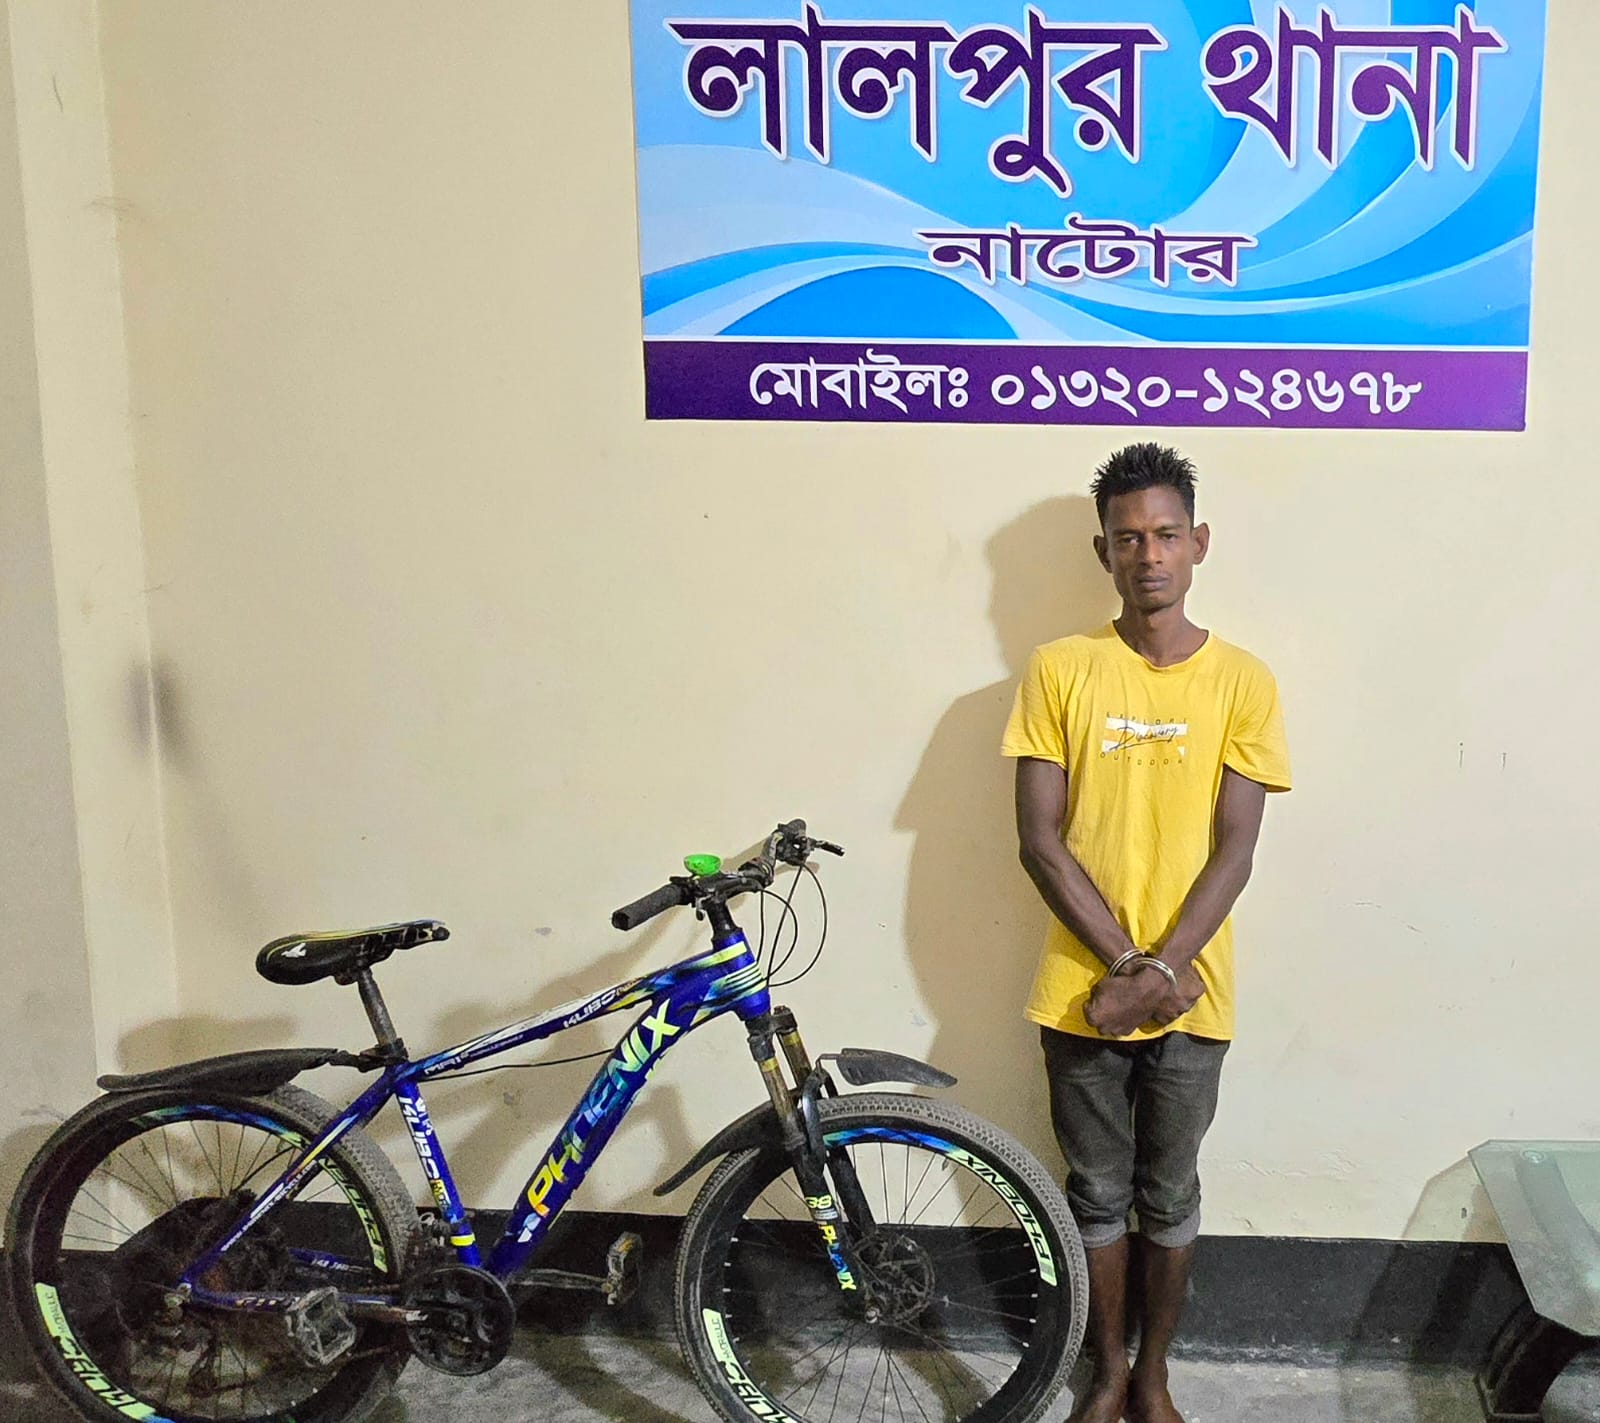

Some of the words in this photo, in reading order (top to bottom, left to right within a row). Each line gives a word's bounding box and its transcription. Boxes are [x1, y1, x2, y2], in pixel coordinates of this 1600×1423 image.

[667, 3, 1163, 195] লালপুর
[1203, 6, 1503, 165] থানা
[918, 215, 1252, 283] নাটোর
[749, 348, 969, 414] মোবাইলঃ
[991, 365, 1423, 417] ০১৩২০-১২৪৬৭৮
[1100, 752, 1183, 765] OUTDOOR
[526, 998, 681, 1217] PHOENIX
[958, 1155, 1050, 1260] PHOENIX
